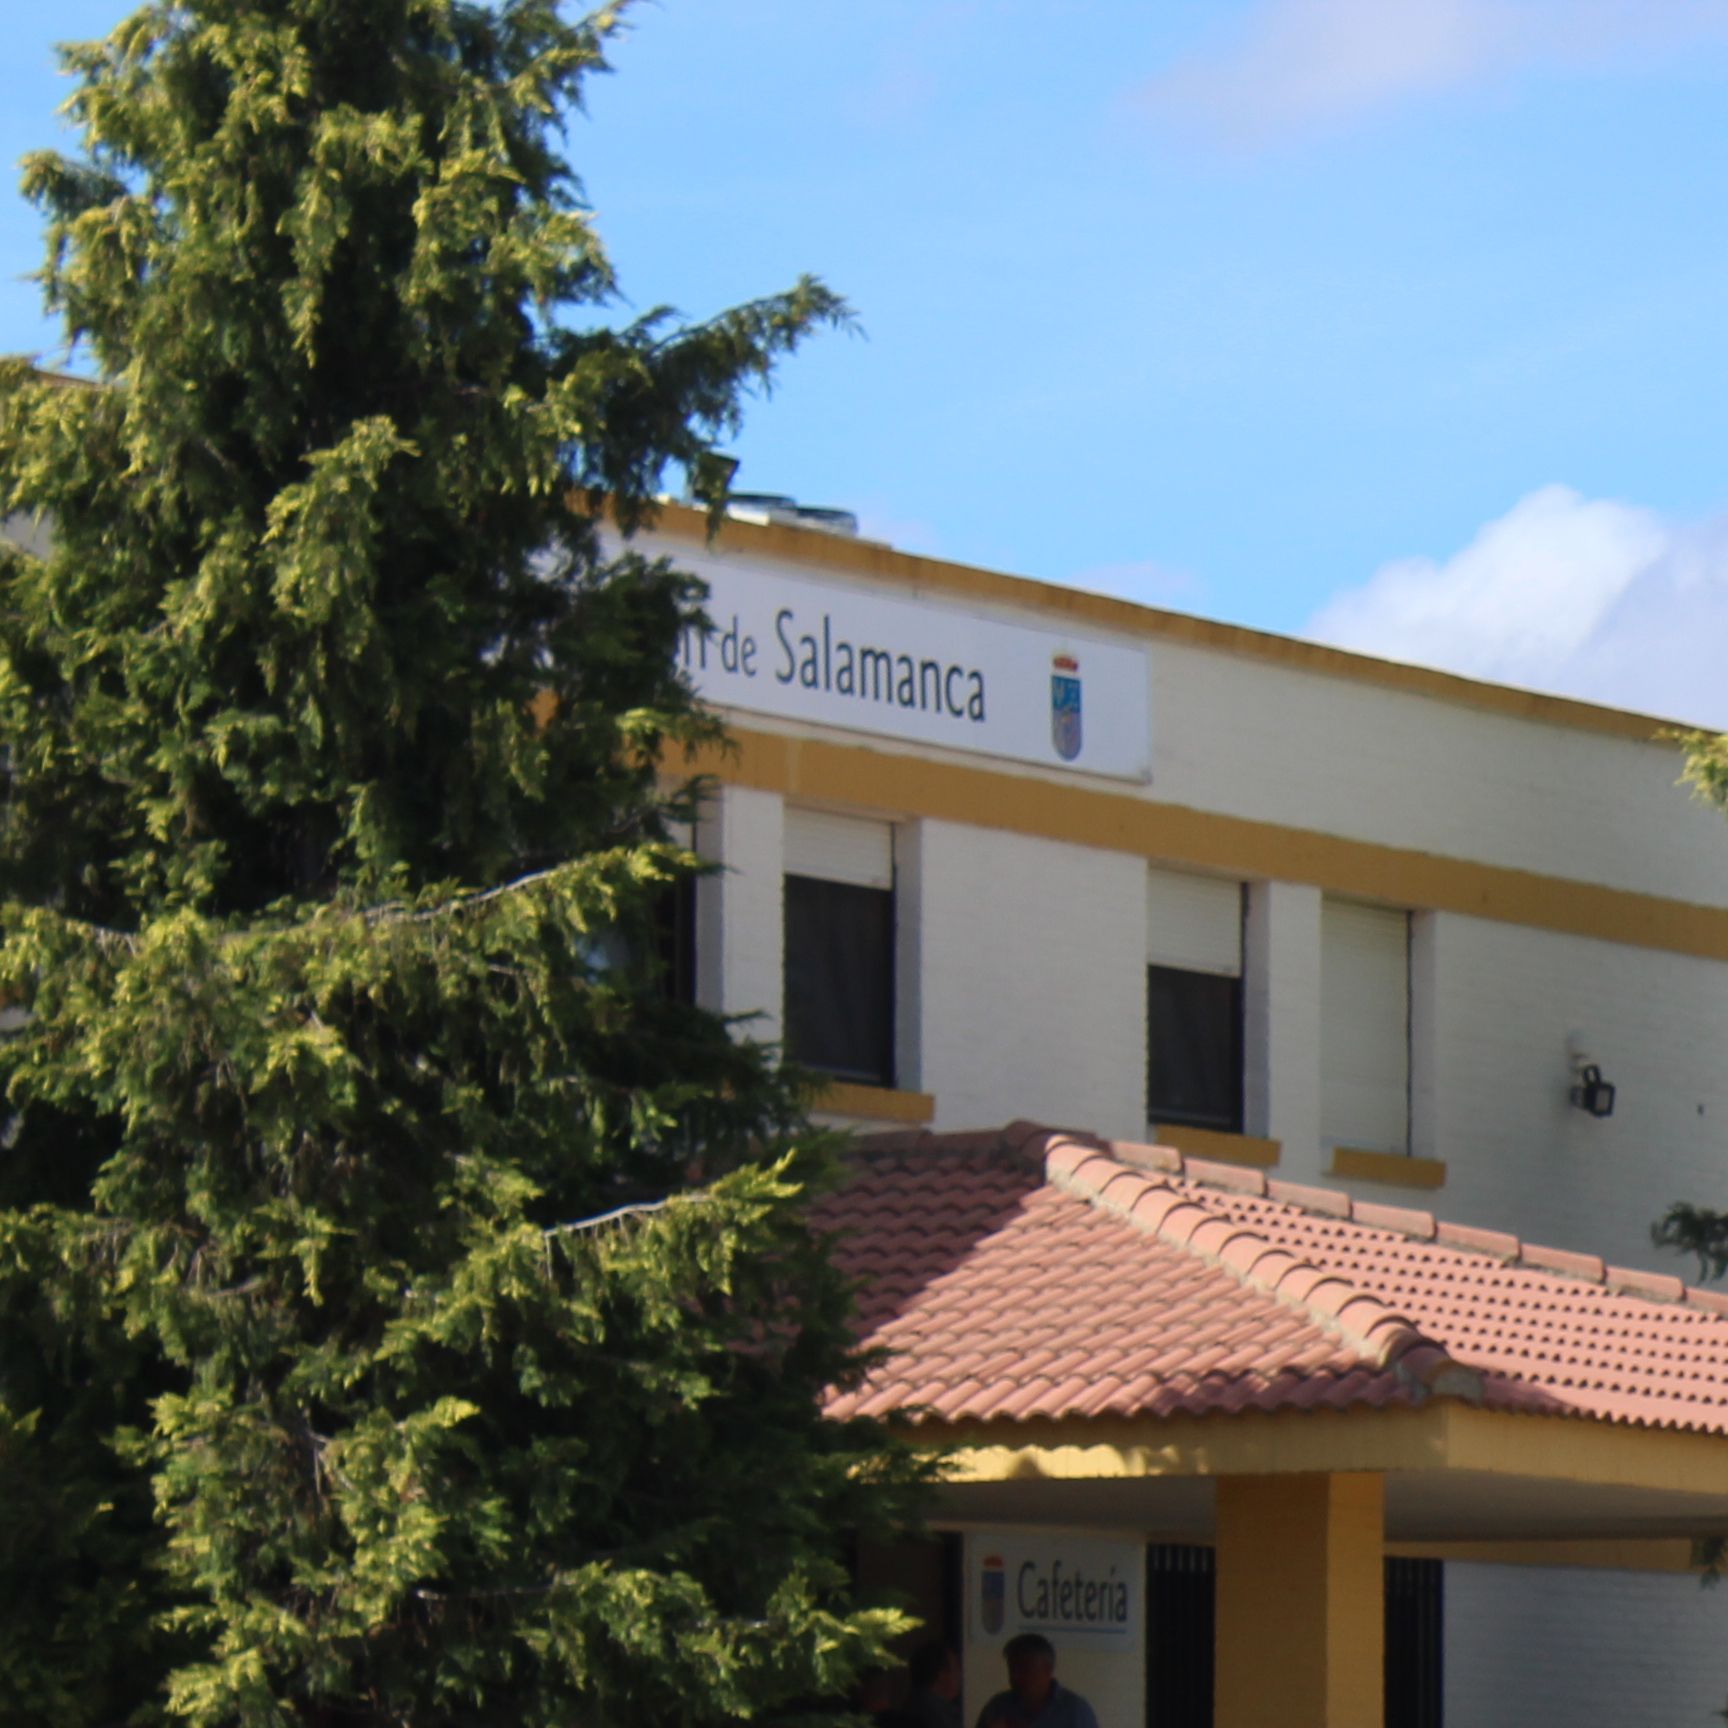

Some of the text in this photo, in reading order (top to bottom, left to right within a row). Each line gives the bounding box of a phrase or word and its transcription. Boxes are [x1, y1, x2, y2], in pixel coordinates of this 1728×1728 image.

[721, 615, 756, 677] de
[775, 609, 986, 723] Salamanca
[1017, 1559, 1127, 1623] Cafetería
